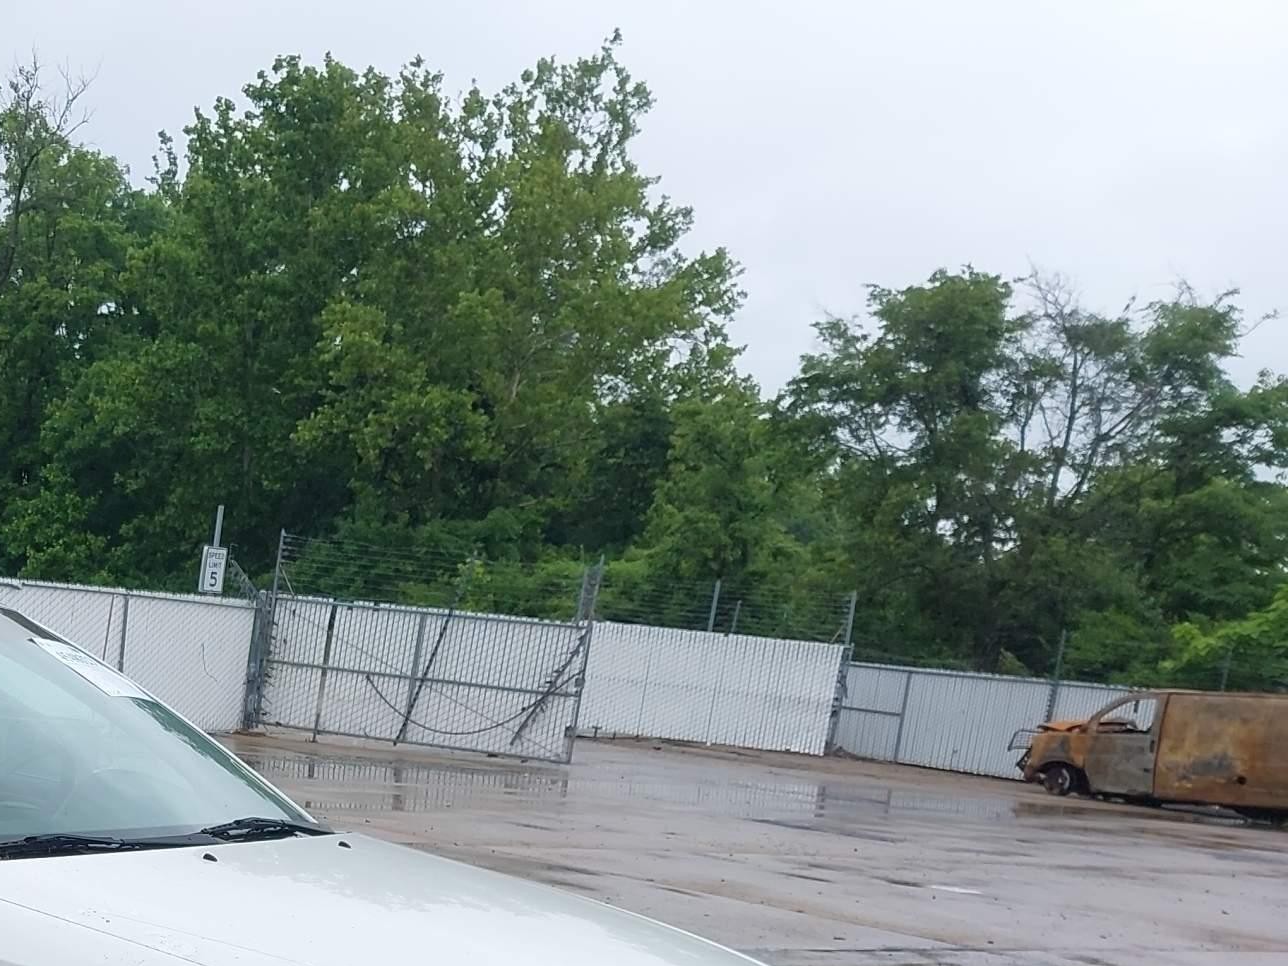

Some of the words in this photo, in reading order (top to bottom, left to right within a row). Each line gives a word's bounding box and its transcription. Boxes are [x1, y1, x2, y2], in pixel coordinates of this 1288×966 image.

[208, 552, 225, 560] SPEED
[208, 561, 222, 569] LIMIT
[209, 571, 218, 587] 5
